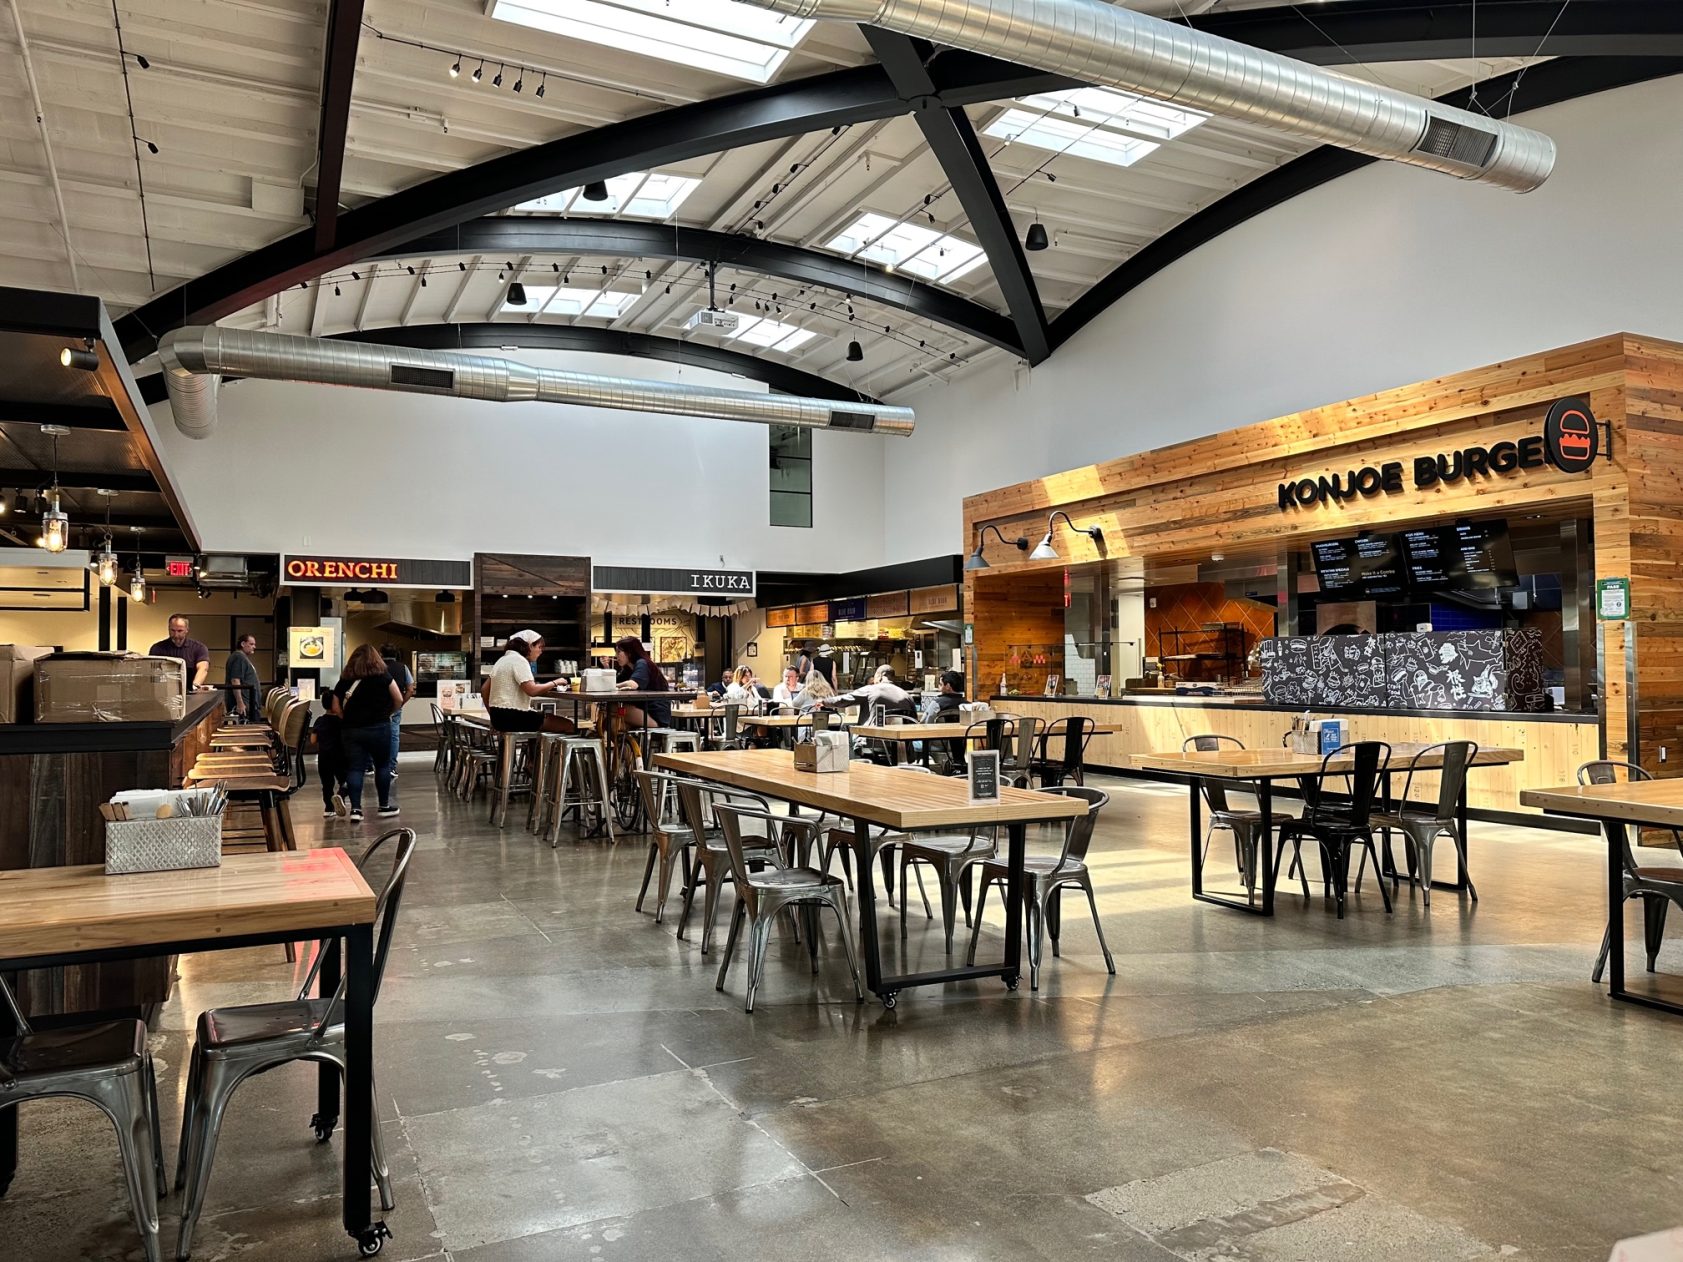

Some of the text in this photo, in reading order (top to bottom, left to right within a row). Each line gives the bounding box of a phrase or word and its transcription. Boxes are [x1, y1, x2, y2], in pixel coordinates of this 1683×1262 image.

[1278, 461, 1404, 509] KONJOE
[170, 562, 190, 576] EXIT
[287, 560, 398, 579] ORENCHI
[690, 574, 751, 589] IKUKA
[619, 617, 678, 626] RESTOOMS
